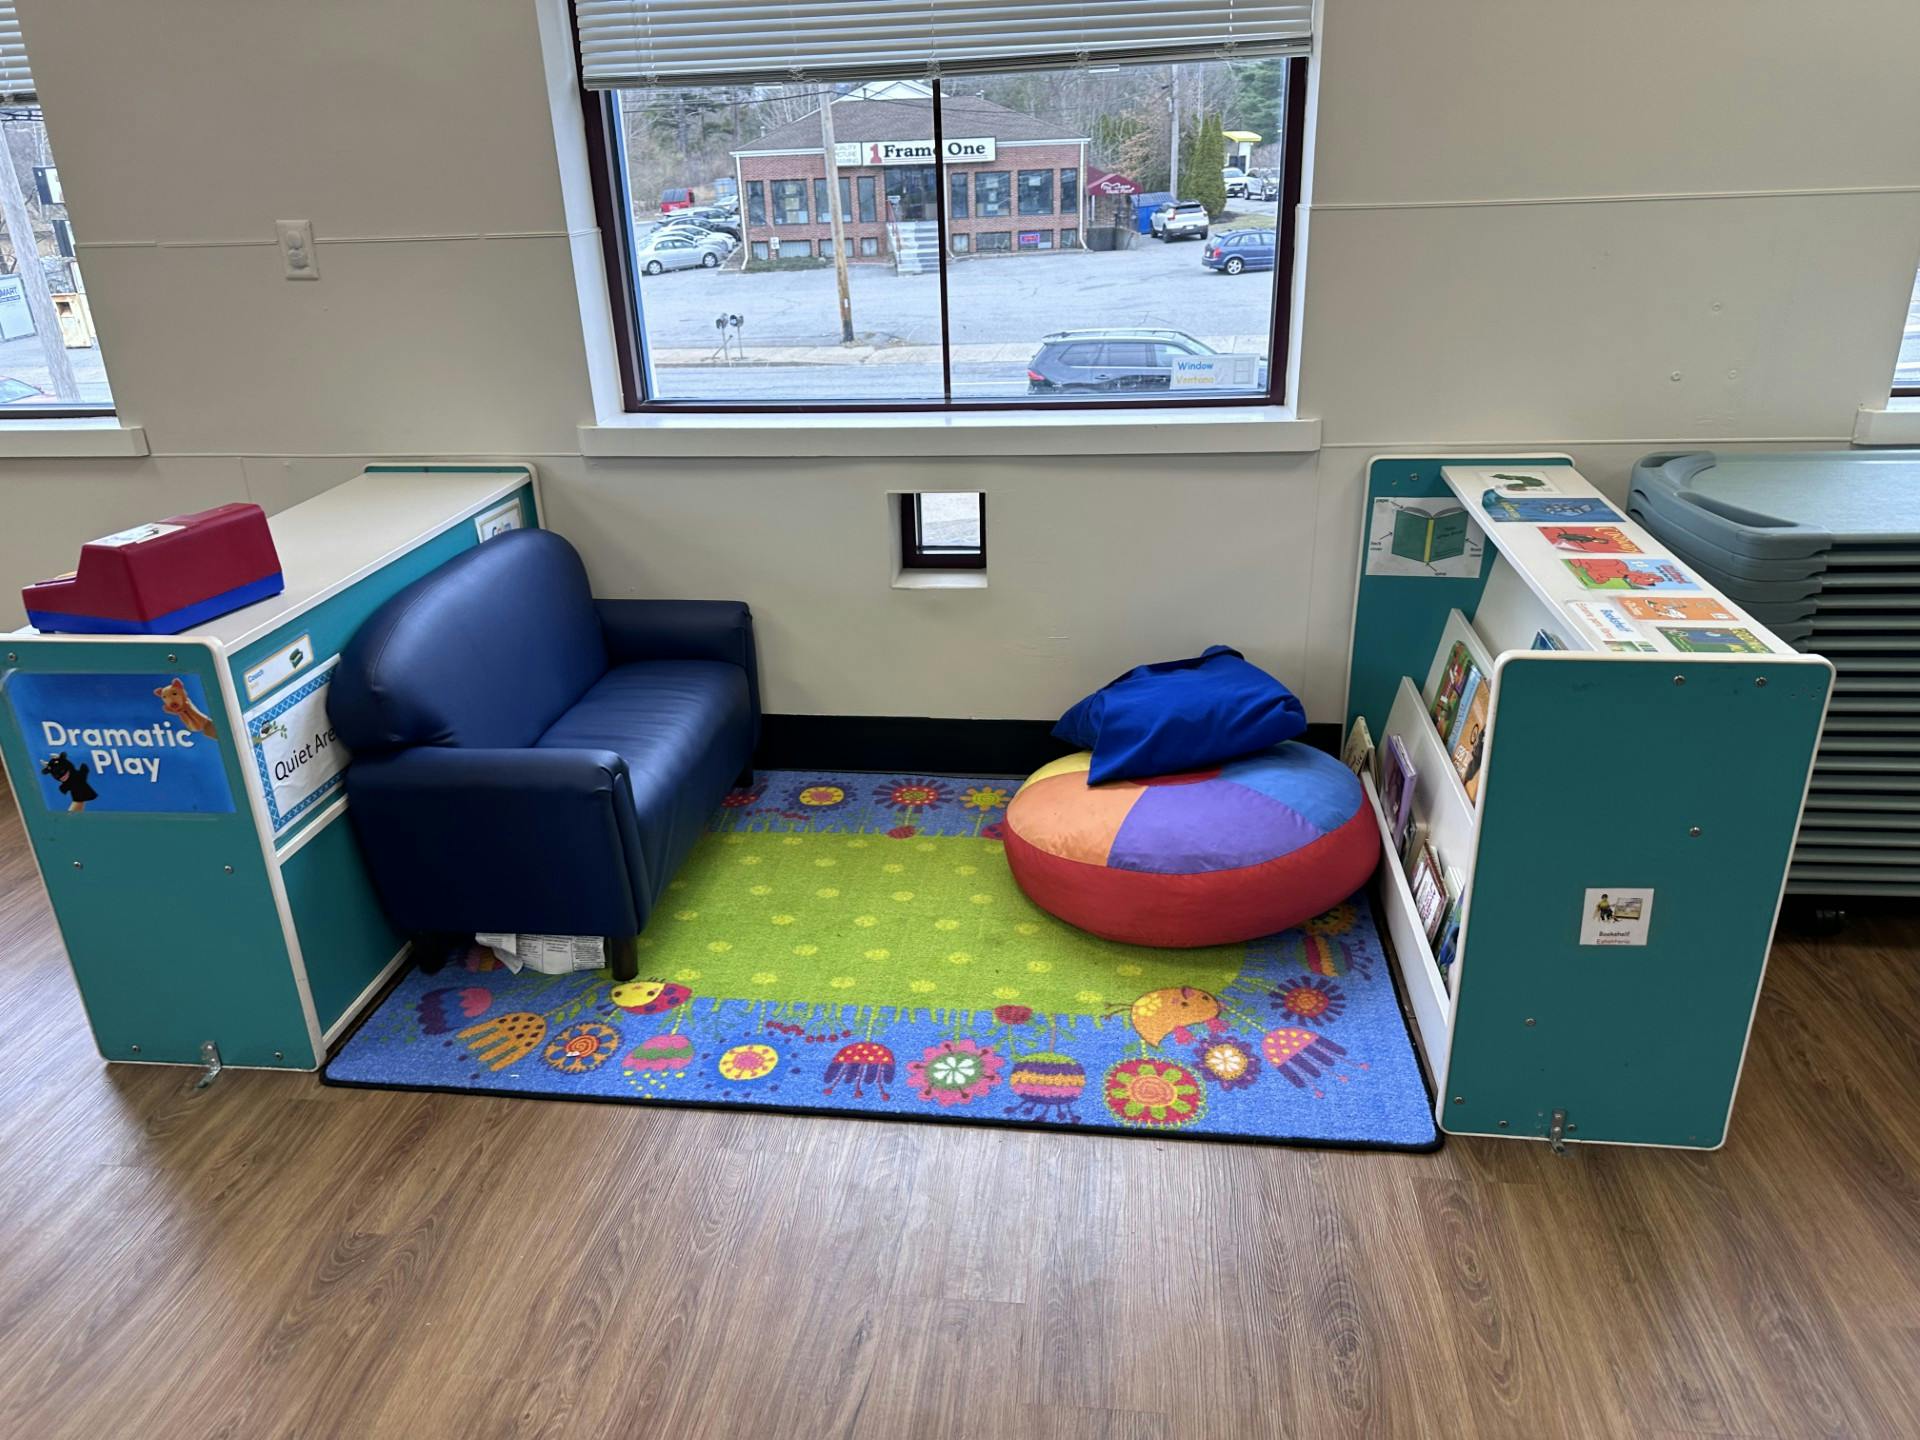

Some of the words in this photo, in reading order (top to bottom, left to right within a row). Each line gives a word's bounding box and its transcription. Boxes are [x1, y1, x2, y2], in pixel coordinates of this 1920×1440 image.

[883, 143, 938, 158] Fram
[947, 141, 986, 156] One
[1177, 361, 1214, 370] Window
[41, 720, 195, 748] Dramatic
[90, 749, 160, 783] Play
[274, 743, 314, 781] Quiet
[314, 727, 337, 754] Are
